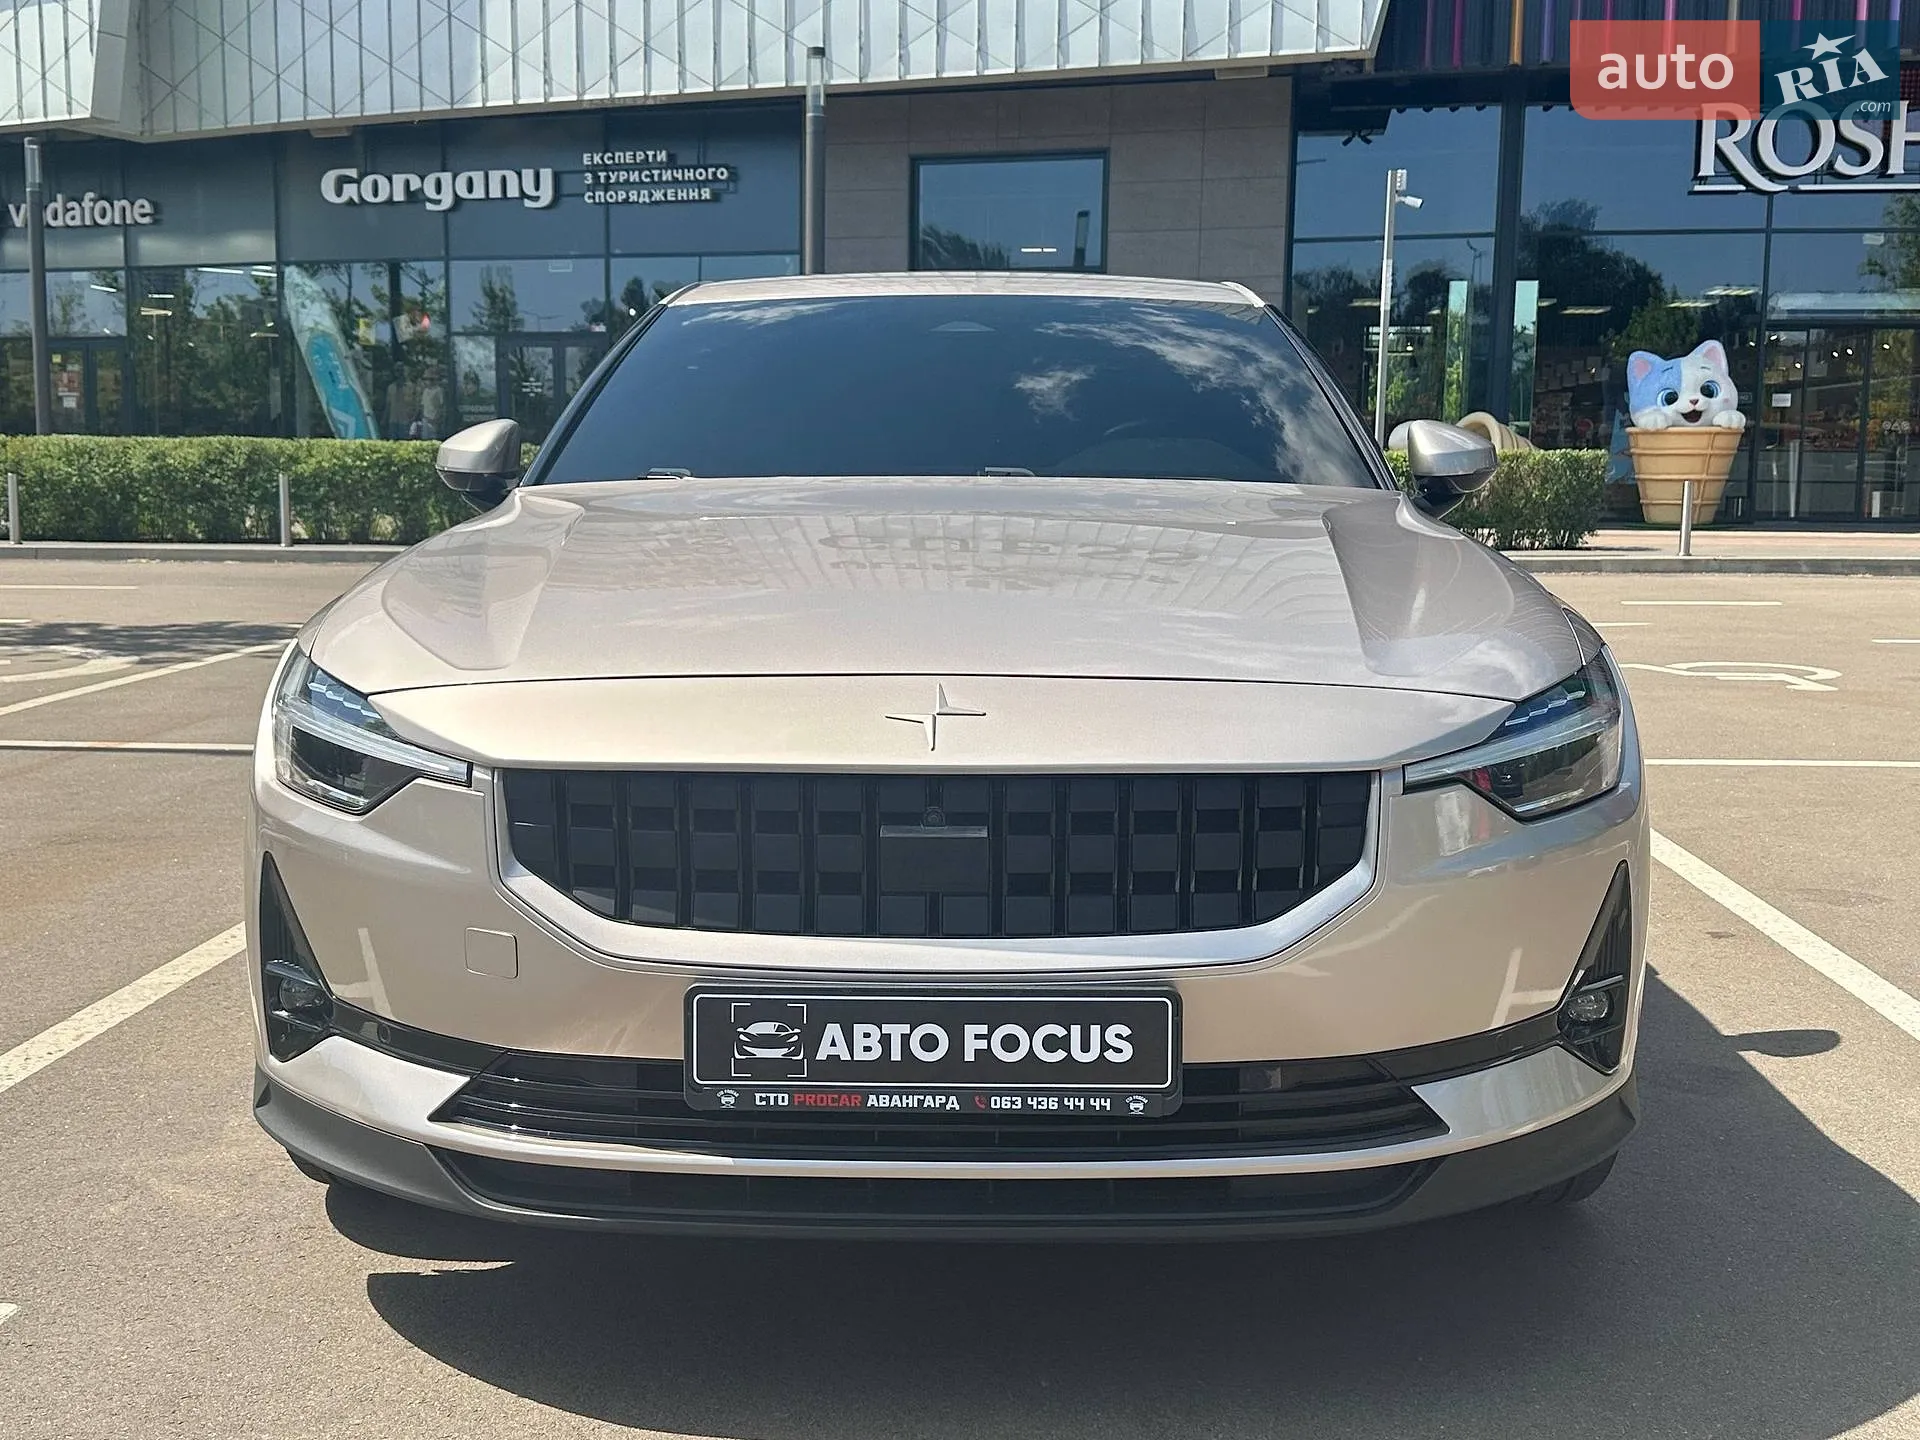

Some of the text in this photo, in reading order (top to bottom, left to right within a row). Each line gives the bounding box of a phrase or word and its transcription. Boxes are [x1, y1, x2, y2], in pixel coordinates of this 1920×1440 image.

[583, 150, 667, 165] ЕКСПЕРТИ
[598, 167, 728, 184] ТУРИСТИЧНОГО
[320, 168, 552, 211] Gorgany
[584, 187, 711, 203] СПОРЯДЖЕННЯ
[8, 191, 154, 228] vdafone
[815, 1023, 1134, 1063] АВТО FOCUS
[755, 1093, 788, 1106] СТО
[794, 1094, 861, 1107] PROCAR
[867, 1094, 960, 1110] АВАНГАРД
[990, 1096, 1021, 1109] 063
[1027, 1097, 1058, 1110] 436
[1064, 1097, 1085, 1110] 44
[1090, 1098, 1111, 1111] 44
